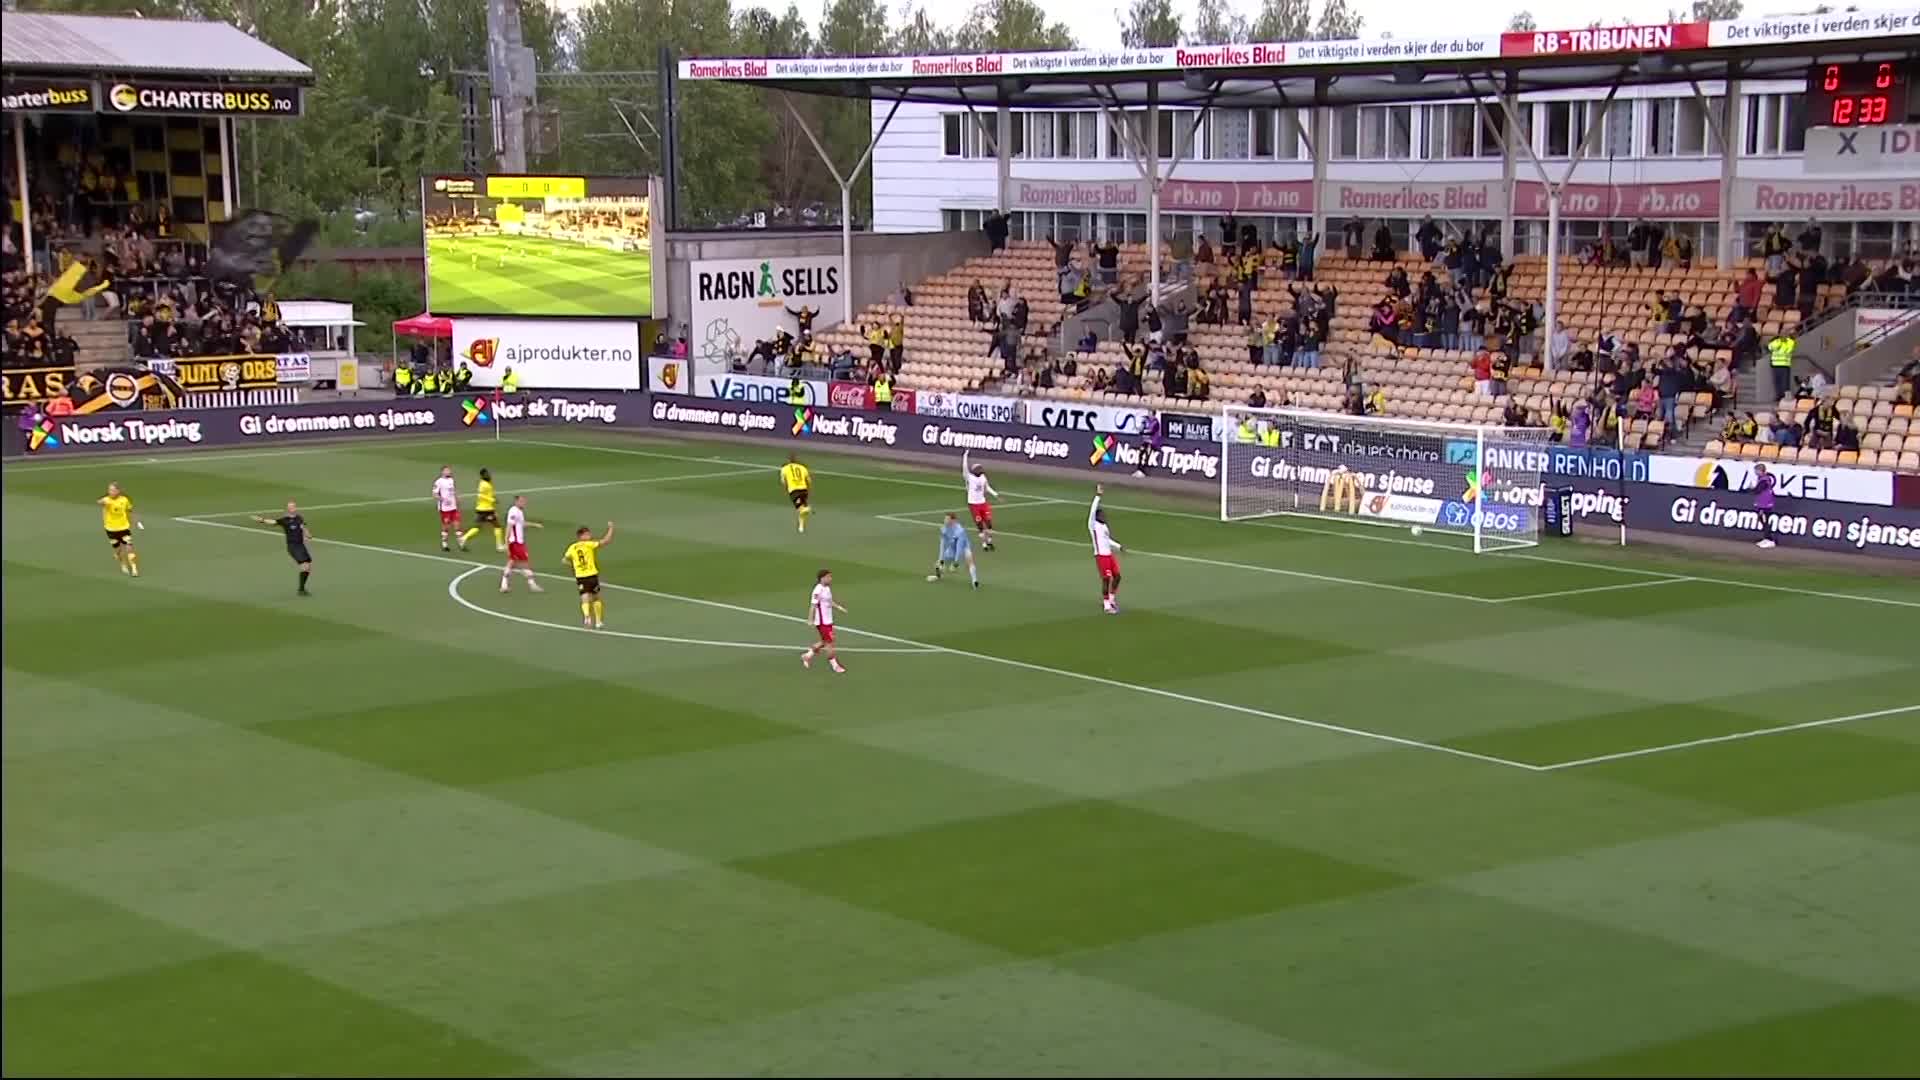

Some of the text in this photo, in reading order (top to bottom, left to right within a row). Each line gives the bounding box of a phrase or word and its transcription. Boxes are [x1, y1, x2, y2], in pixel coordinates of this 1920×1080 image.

[1728, 25, 1749, 39] Det
[1753, 22, 1810, 39] viktigste
[1822, 16, 1869, 32] verden
[1873, 14, 1908, 32] skjer
[1534, 27, 1672, 53] RB-TRIBUNEN
[912, 56, 1003, 74] Romerikes Blad
[1177, 45, 1285, 66] Romerikes Blad
[690, 61, 768, 78] Romerikes Blad
[1824, 64, 1890, 91] 0 0
[140, 89, 291, 112] CHARTERBUSS.no
[1837, 131, 1858, 155] X
[1019, 183, 1137, 206] Romerikes Blad
[1173, 186, 1299, 207] rb.no rb.no
[1339, 185, 1487, 210] Romerikes Blad
[1535, 187, 1701, 212] r.no rb.no
[1756, 184, 1893, 211] Romerikes
[700, 266, 839, 301] RAGN SELLS
[506, 344, 632, 364] ajprodukter.no
[240, 407, 435, 435] Gi drømmen en sjanse
[550, 399, 617, 422] Tipping
[653, 401, 776, 431] Gi drømmen en sjanse
[957, 402, 988, 419] COMET
[1042, 407, 1097, 432] SATS
[62, 419, 201, 444] Norsk Tipping
[812, 415, 897, 444] Norsk Tipping
[922, 424, 1069, 460] Gi drømmen en sjanse
[1186, 423, 1209, 436] ALIVE
[1115, 442, 1219, 478] Nork Tipping
[1485, 448, 1646, 482] ANKER RENHOD
[1251, 455, 1271, 477] Gi
[1355, 471, 1375, 489] en
[1379, 469, 1434, 496] sjanse
[1571, 489, 1623, 522] pping
[1471, 511, 1519, 530] OBOS
[1671, 497, 1697, 524] Gi
[1812, 516, 1842, 539] en
[1847, 516, 1920, 548] sjanse
